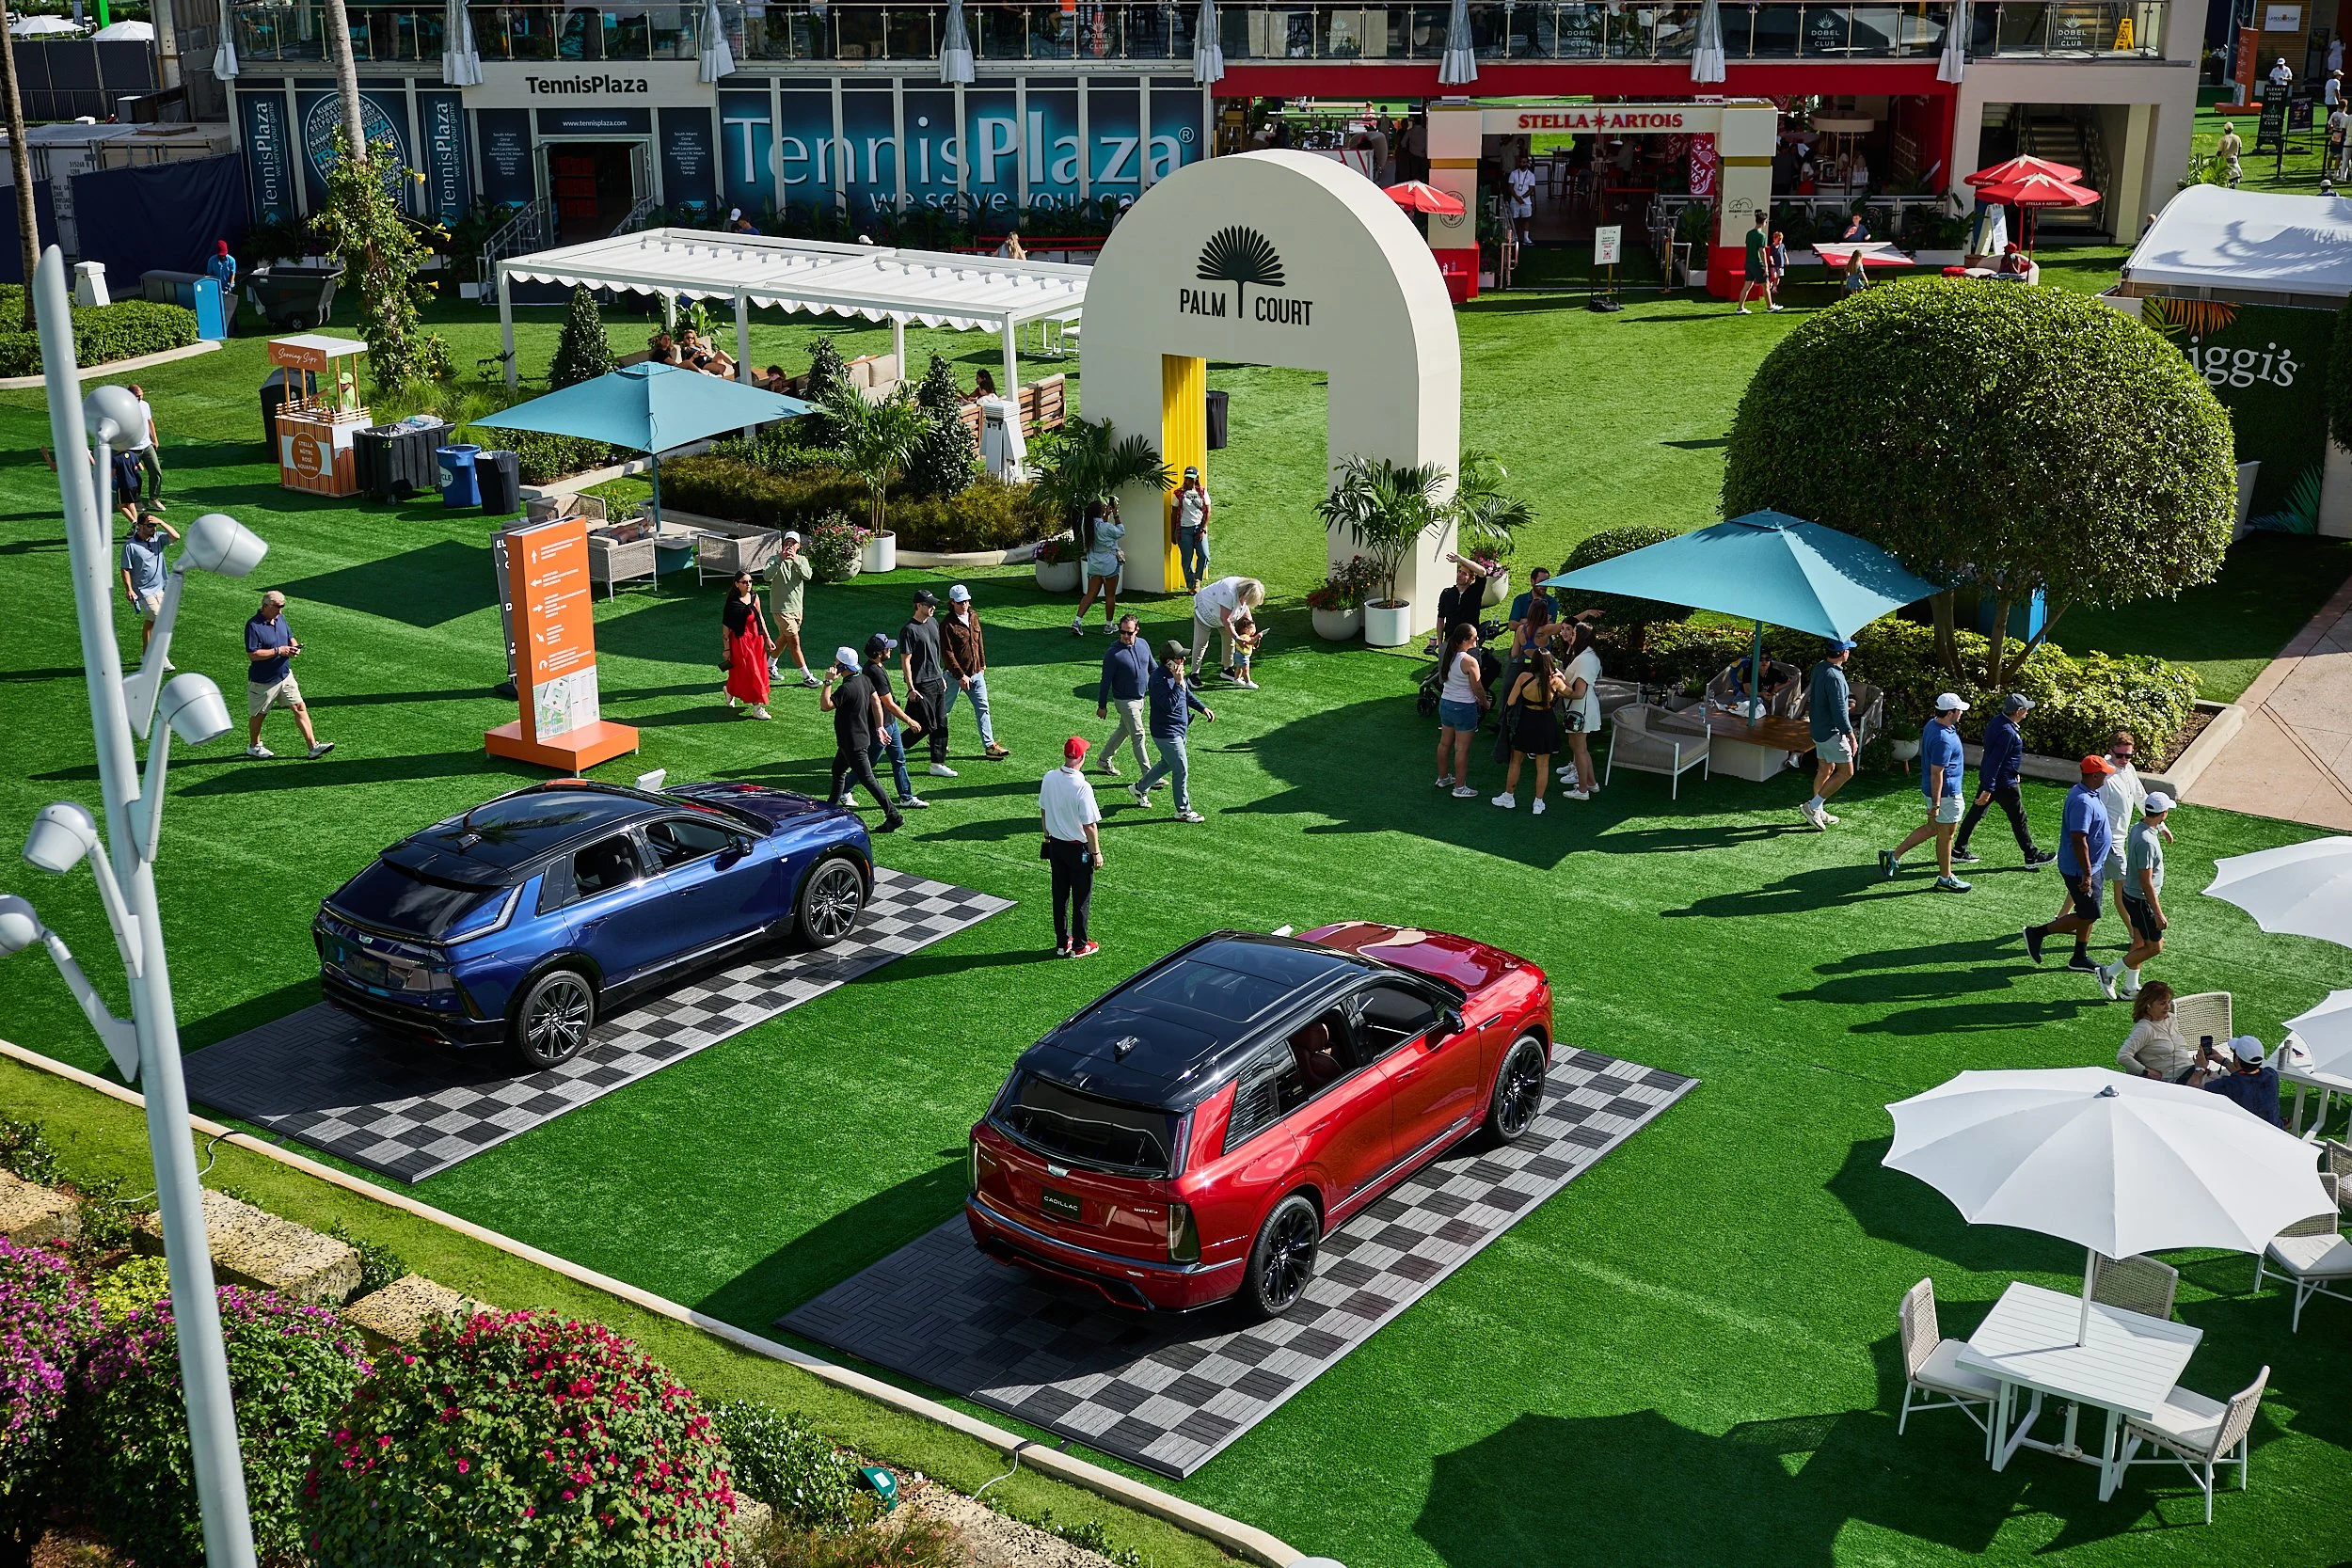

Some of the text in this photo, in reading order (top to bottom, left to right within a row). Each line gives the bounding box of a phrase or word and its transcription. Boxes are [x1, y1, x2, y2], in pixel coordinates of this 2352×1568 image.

[525, 74, 648, 94] TennisPlaza
[267, 102, 278, 123] game
[310, 104, 342, 125] NAVRATI
[316, 98, 342, 115] KUERT
[449, 102, 458, 124] game
[1518, 113, 1683, 128] STELLA ARTOIS
[270, 123, 279, 143] your
[255, 103, 278, 210] TennisPlaza
[435, 103, 456, 210] TennisPlaza
[869, 193, 914, 214] we
[1180, 288, 1313, 326] PALM COURT
[1043, 1196, 1078, 1212] CADILLAC
